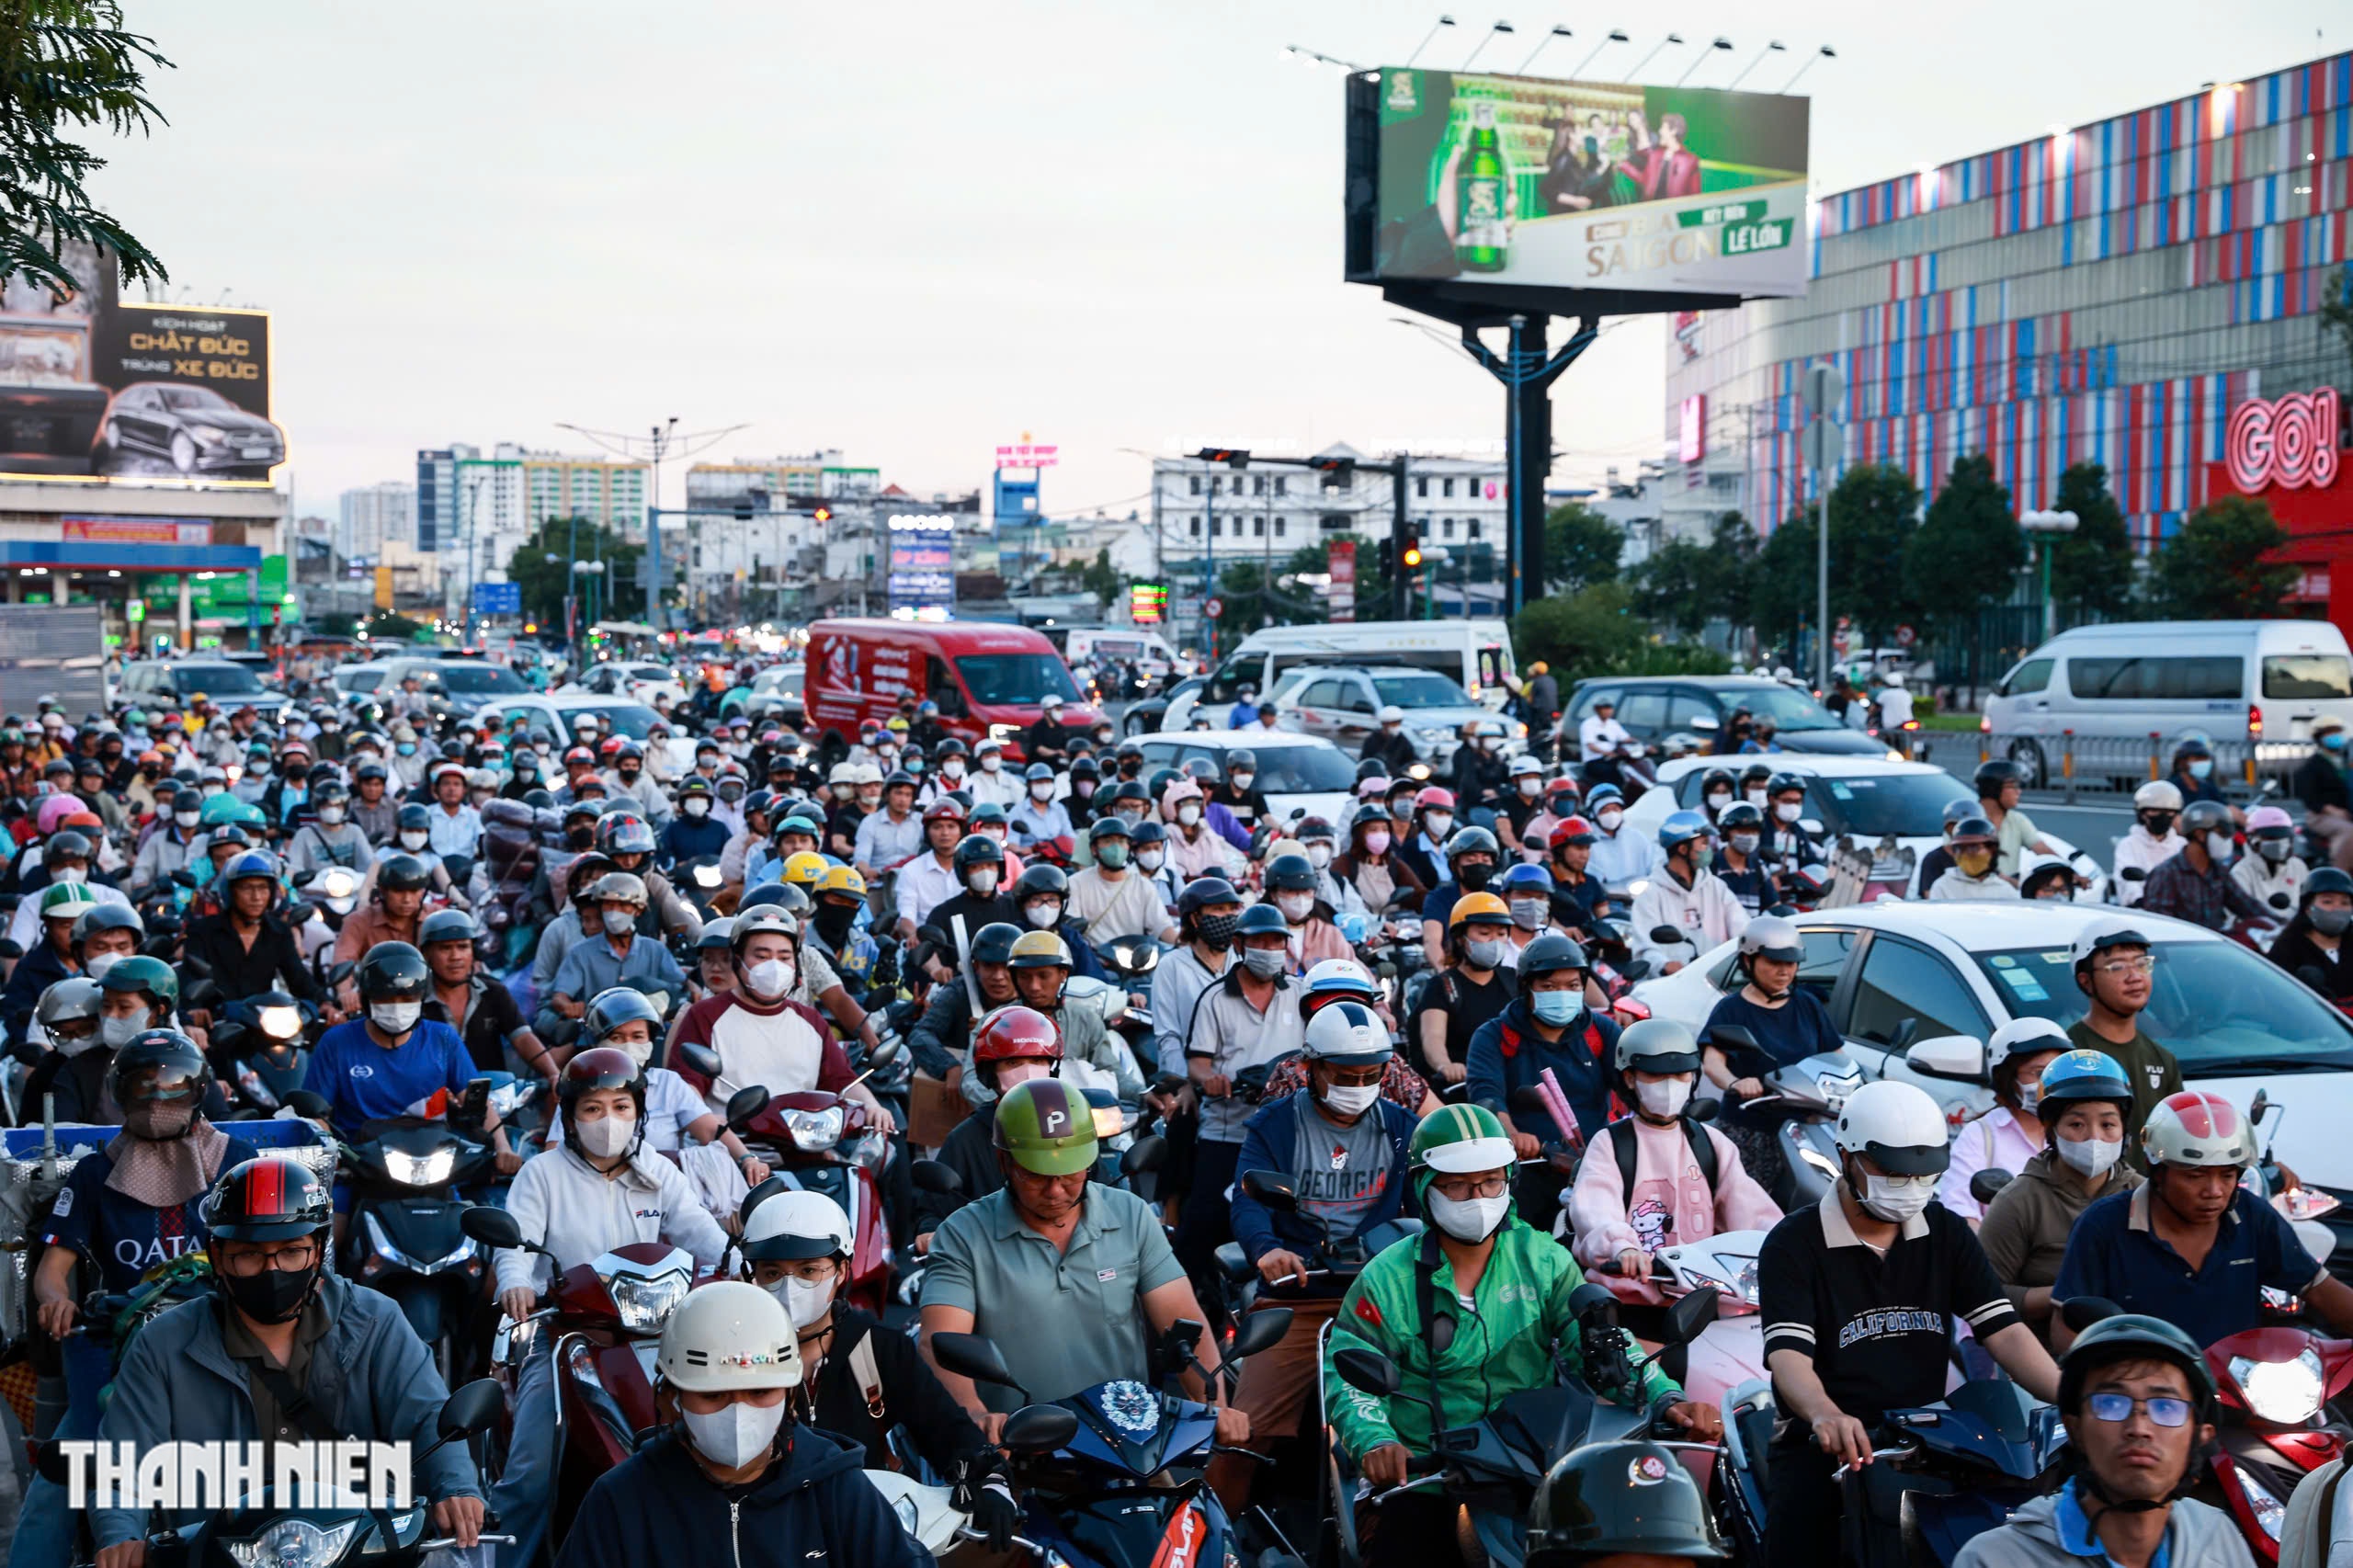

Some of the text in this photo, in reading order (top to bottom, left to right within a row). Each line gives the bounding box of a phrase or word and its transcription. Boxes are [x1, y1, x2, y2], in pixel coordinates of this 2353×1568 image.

[1586, 227, 1718, 278] SAIGON
[174, 359, 205, 378] XE
[2225, 386, 2338, 494] GO!
[2145, 1064, 2165, 1074] VLU
[1299, 1166, 1386, 1199] GEORGIA
[635, 1209, 660, 1219] FILA
[114, 1234, 203, 1270] QATA
[1839, 1311, 1945, 1348] CALIFORNIA
